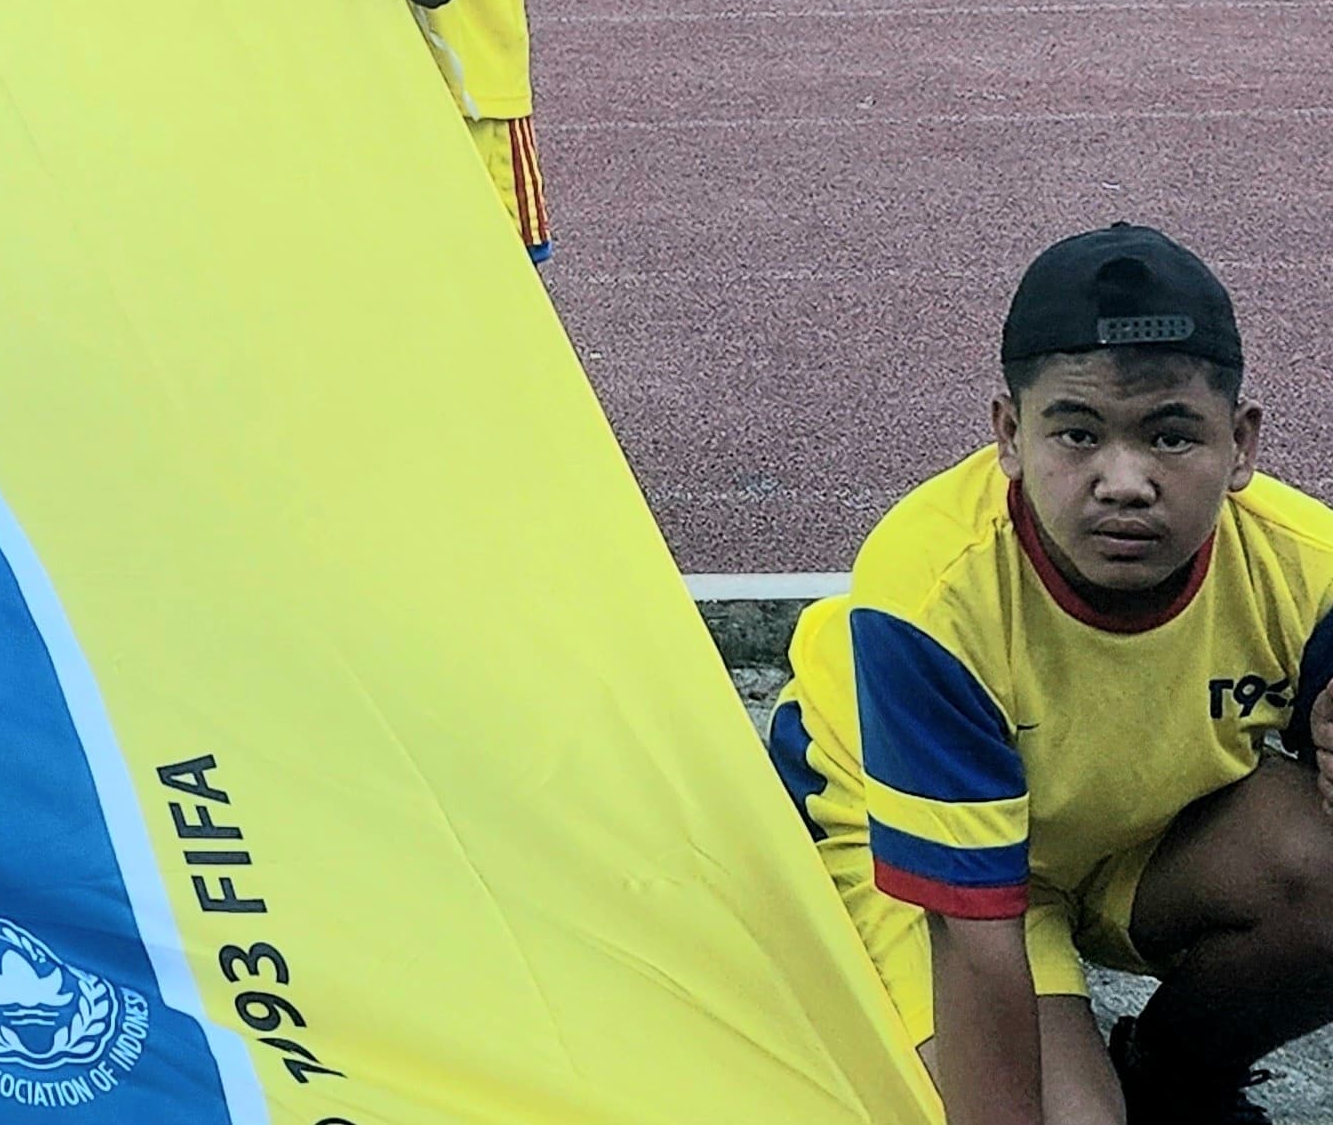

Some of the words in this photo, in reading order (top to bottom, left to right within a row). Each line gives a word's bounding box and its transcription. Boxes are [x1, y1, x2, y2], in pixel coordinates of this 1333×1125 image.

[156, 754, 268, 914] FIFA
[89, 1061, 119, 1092] OF
[109, 987, 149, 1072] INDONES
